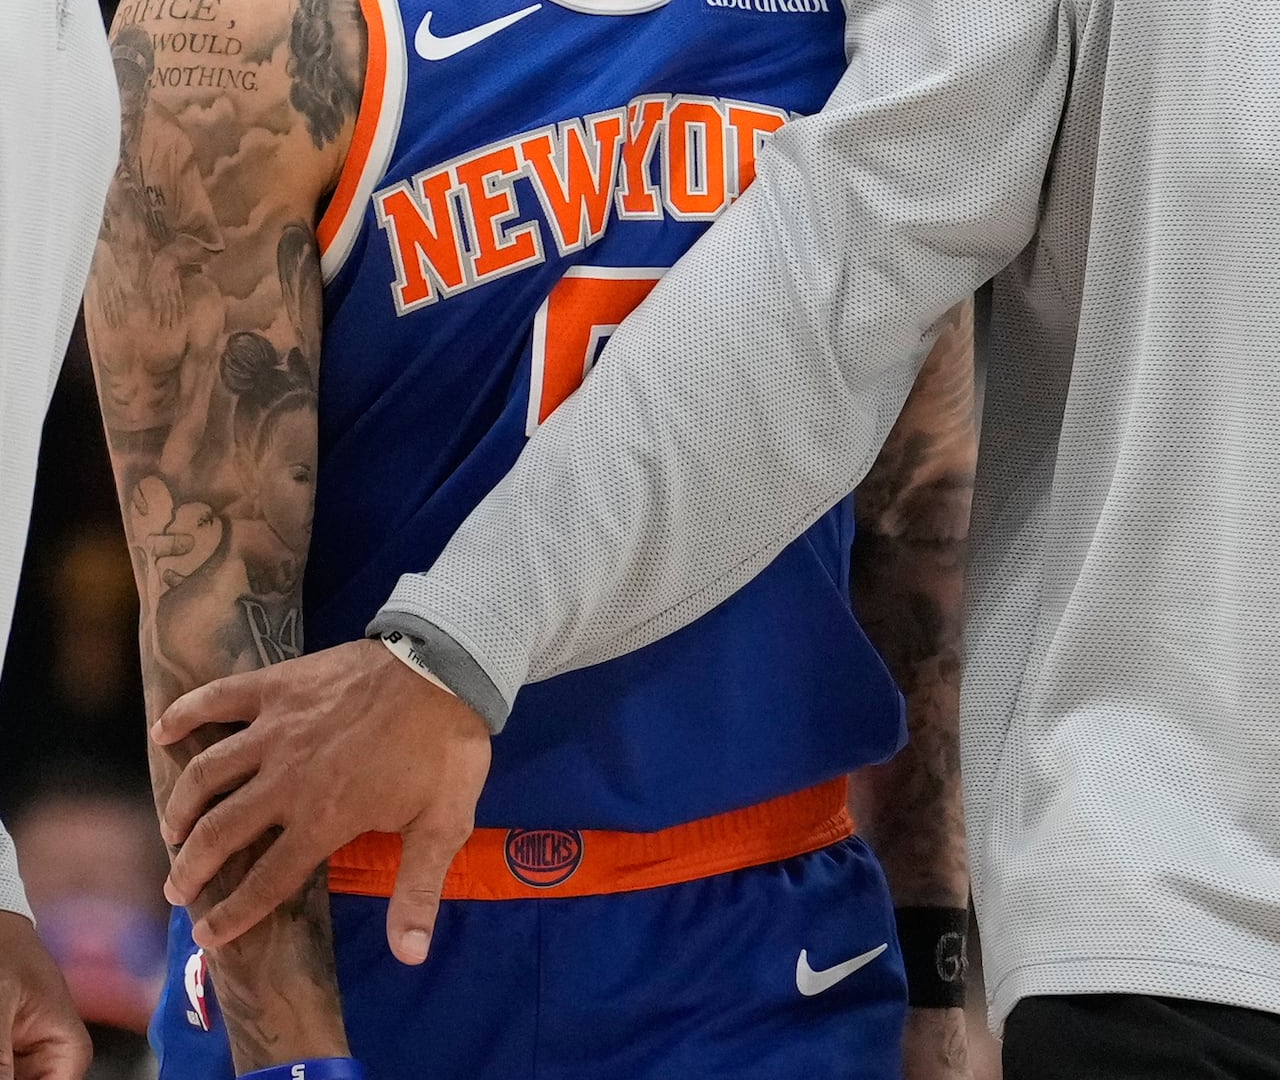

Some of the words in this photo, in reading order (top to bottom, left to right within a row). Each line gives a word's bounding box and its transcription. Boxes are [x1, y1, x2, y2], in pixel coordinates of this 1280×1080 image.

[153, 32, 242, 56] WOULD
[372, 106, 626, 317] NEW
[514, 834, 573, 866] KNICKS
